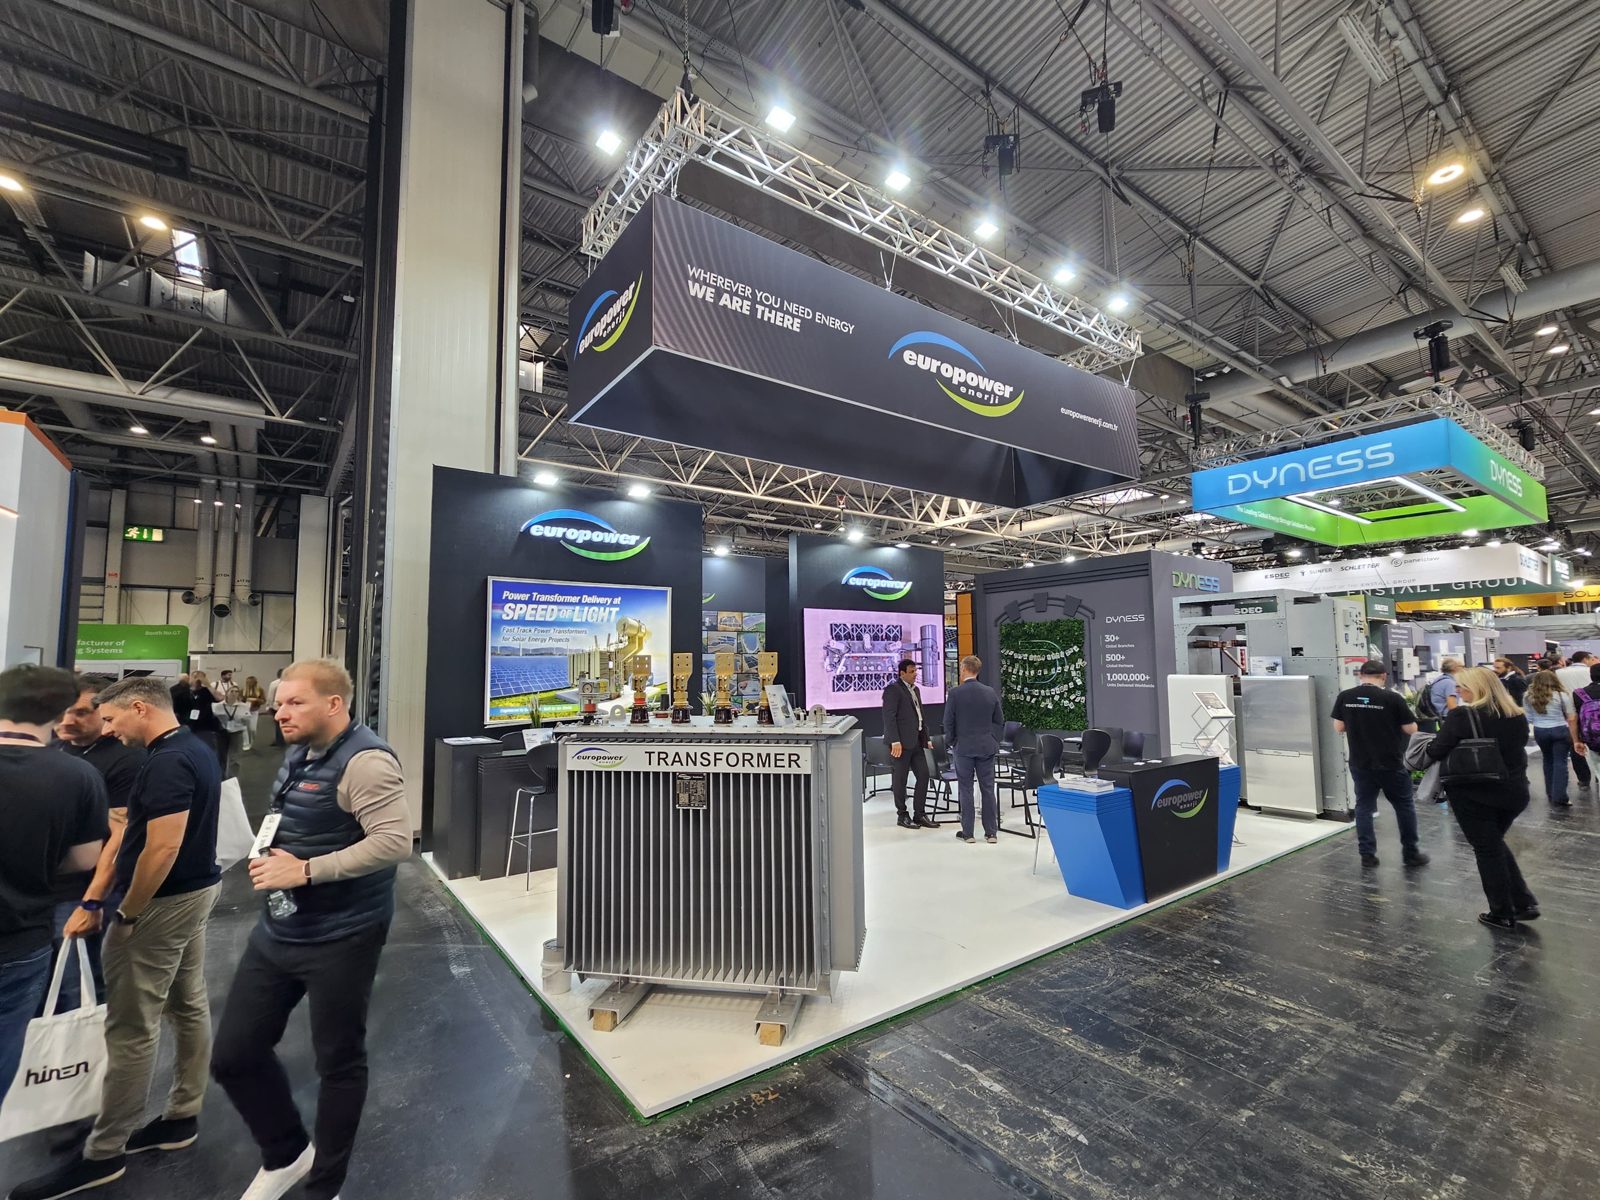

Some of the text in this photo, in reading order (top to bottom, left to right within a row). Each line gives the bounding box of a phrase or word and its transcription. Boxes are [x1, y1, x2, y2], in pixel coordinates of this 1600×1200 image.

[687, 264, 855, 335] WHEREVER YOU NEED ENERGY
[687, 280, 801, 332] WE ARE THERE
[578, 281, 635, 354] europower
[902, 349, 1014, 398] europower
[959, 386, 999, 404] enerji
[1060, 406, 1118, 431] europowerenerji.com.tr
[1228, 442, 1395, 495] DYNESS
[1490, 459, 1523, 498] DYNESS
[529, 524, 640, 545] europower
[848, 577, 906, 589] europower
[1172, 570, 1220, 593] DYNESS
[502, 590, 621, 606] Power Transformer Delivery at
[1436, 598, 1479, 607] SOLAX
[501, 603, 620, 623] SPEED OF LIGHT
[1105, 614, 1145, 624] DYNESS
[1104, 634, 1120, 642] 30+
[86, 647, 123, 655] Systems
[1105, 653, 1126, 661] 500+
[1106, 673, 1151, 682] 1,000,000+
[645, 751, 802, 768] TRANSFORMER
[1156, 789, 1204, 808] europower
